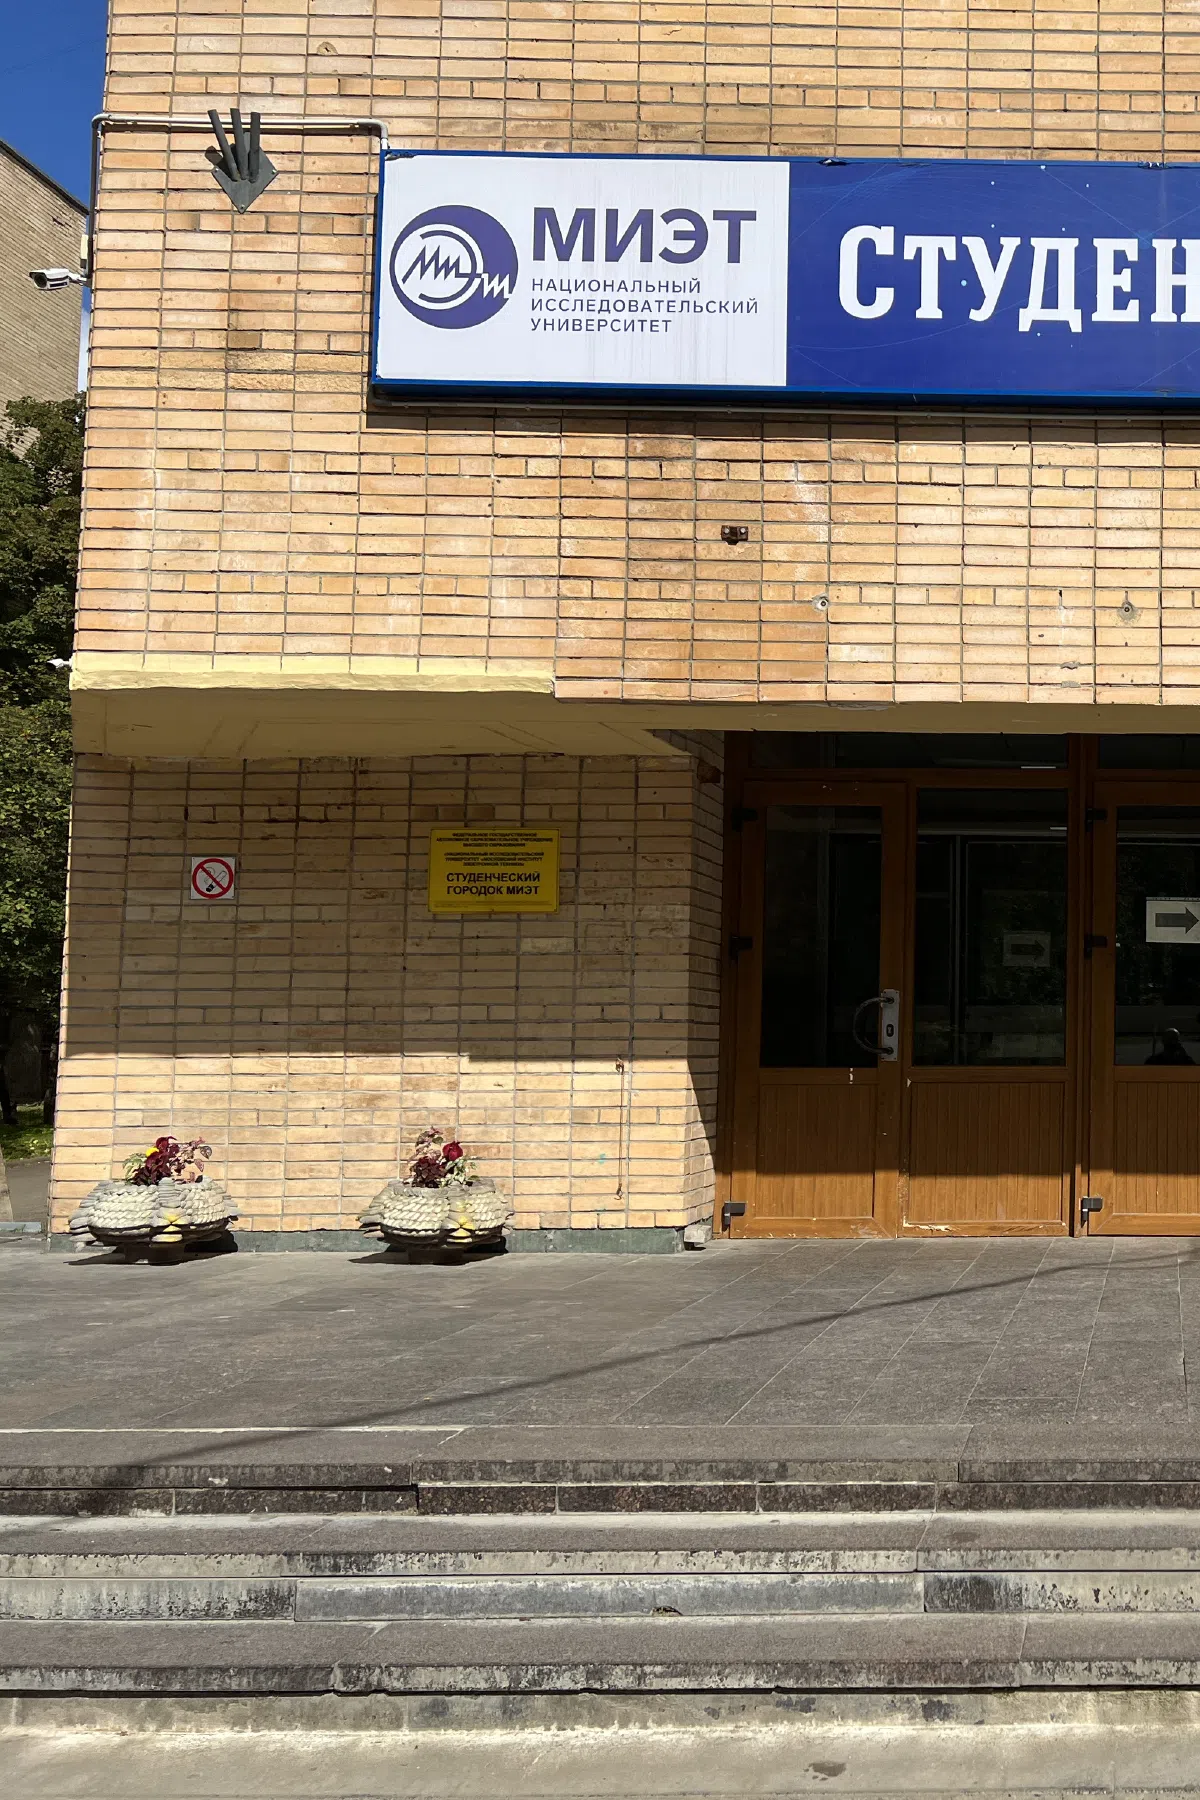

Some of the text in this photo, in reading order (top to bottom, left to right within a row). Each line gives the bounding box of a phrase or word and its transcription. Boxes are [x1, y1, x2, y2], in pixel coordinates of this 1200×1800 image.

[532, 206, 757, 264] МИЭТ
[532, 277, 701, 295] НАЦИОНАЛЬНЫЙ
[531, 297, 758, 315] ИССЛЕДОВАТЕЛЬСКИЙ
[531, 318, 672, 333] УНИВЕРСИТЕТ
[446, 871, 541, 884] СТУДЕНЧЕСКИЙ
[446, 886, 540, 897] ГОРОДОК МИЭТ
